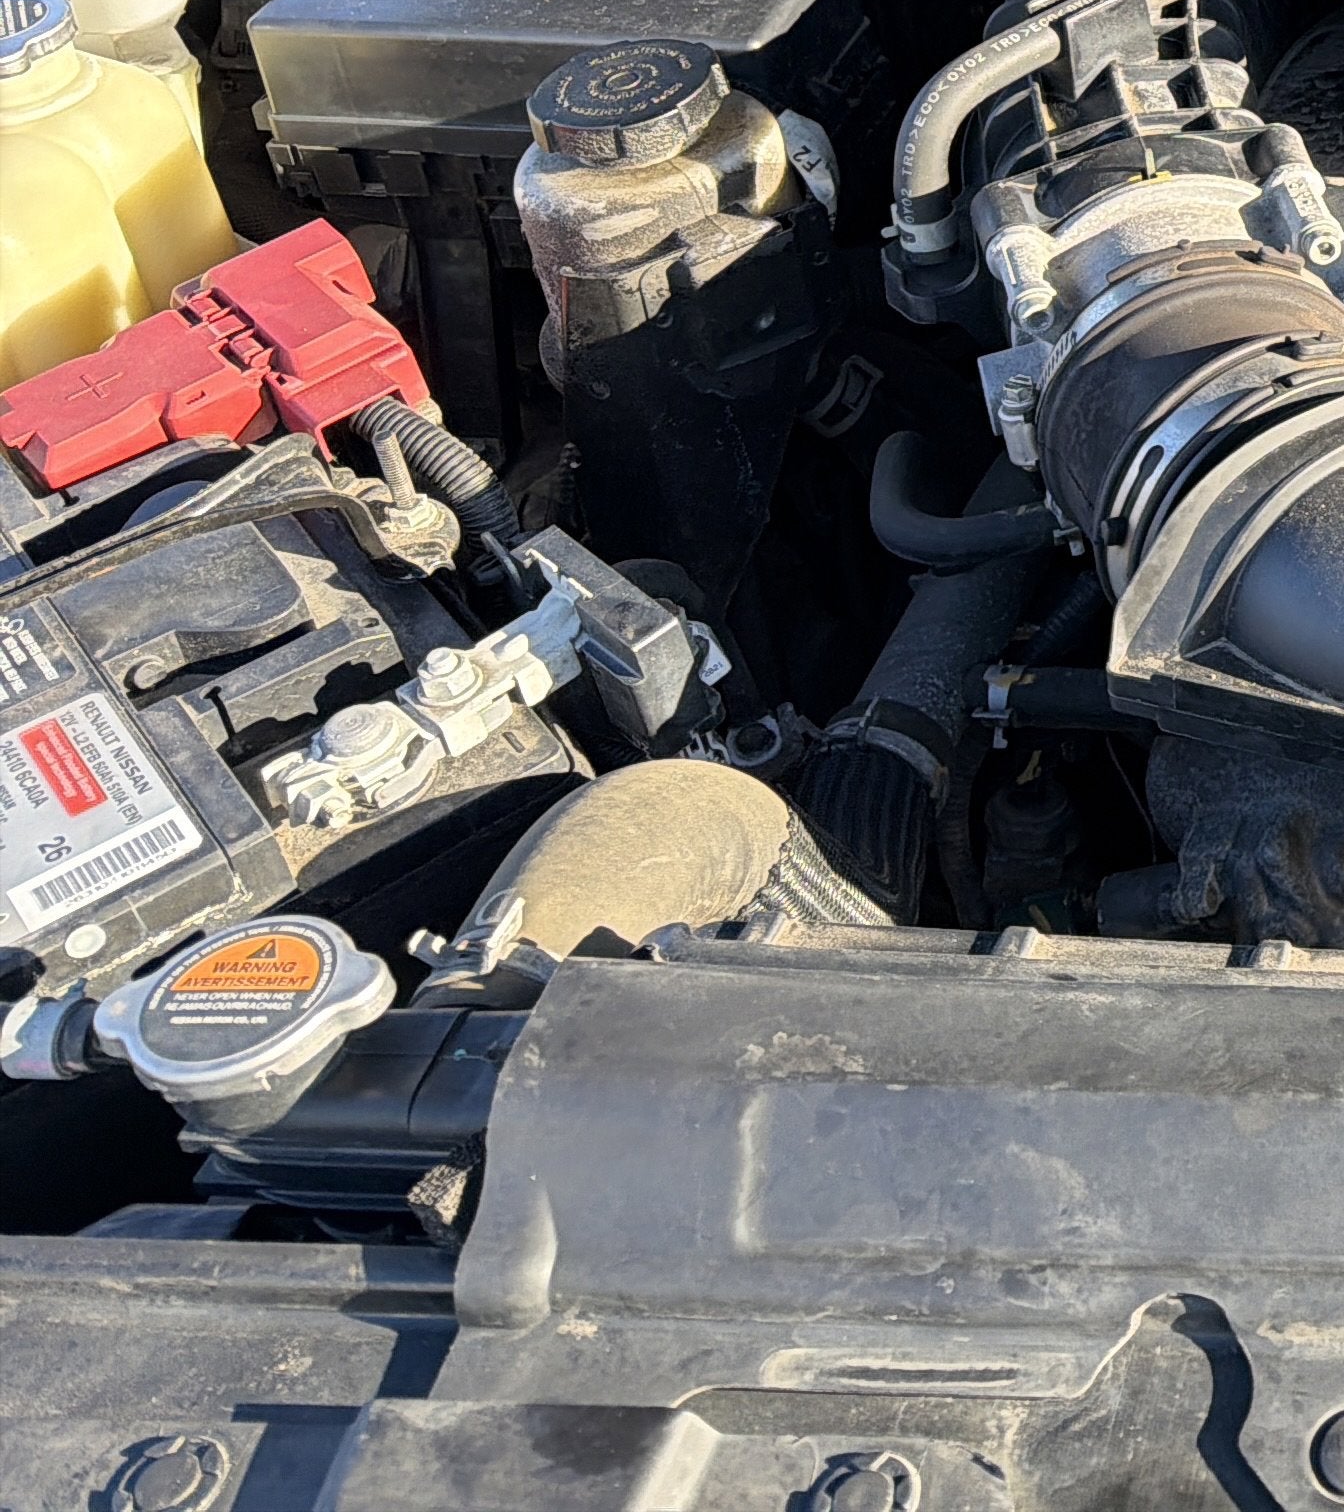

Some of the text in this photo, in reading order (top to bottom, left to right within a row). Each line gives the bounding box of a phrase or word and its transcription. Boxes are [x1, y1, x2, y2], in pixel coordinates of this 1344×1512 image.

[59, 711, 79, 727] 12V
[73, 731, 90, 746] L2
[80, 700, 153, 795] RENAULT NISSAN
[0, 740, 27, 773] 24410
[80, 742, 102, 763] EFB
[92, 761, 115, 785] 60Ah
[107, 782, 130, 806] 510A
[117, 803, 143, 826] (EN)
[38, 835, 72, 863] 26
[213, 961, 297, 974] WARNING
[180, 976, 309, 987] AVERTISSEMENT
